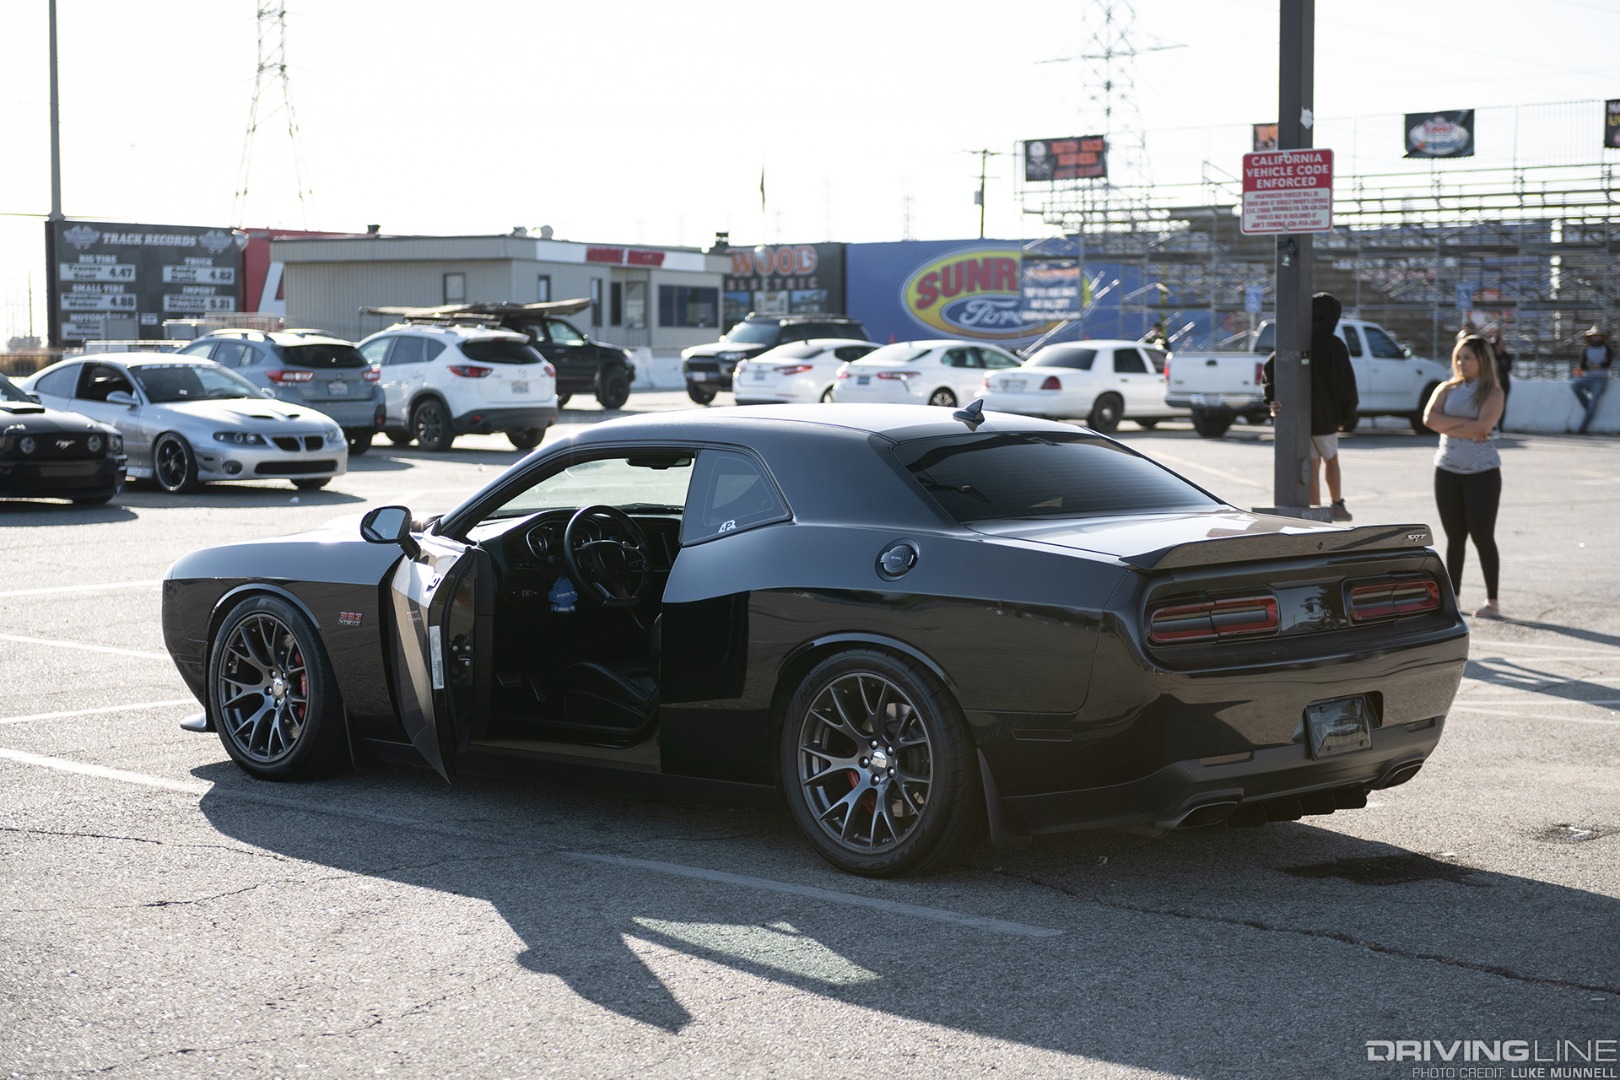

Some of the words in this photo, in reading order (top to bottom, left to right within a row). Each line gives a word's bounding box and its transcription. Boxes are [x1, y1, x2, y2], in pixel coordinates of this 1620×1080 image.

[1251, 153, 1323, 166] CALIFORNIA
[1246, 166, 1294, 177] VEHICLE
[1297, 164, 1329, 175] CODE
[1256, 176, 1317, 188] ENFORCED
[102, 232, 142, 246] TRACK
[144, 233, 197, 247] RECORDS
[725, 245, 818, 277] WOOD
[726, 277, 818, 290] ELETRIC
[915, 257, 1018, 310] SUNR
[959, 300, 1022, 325] For
[1405, 533, 1427, 542] SRT
